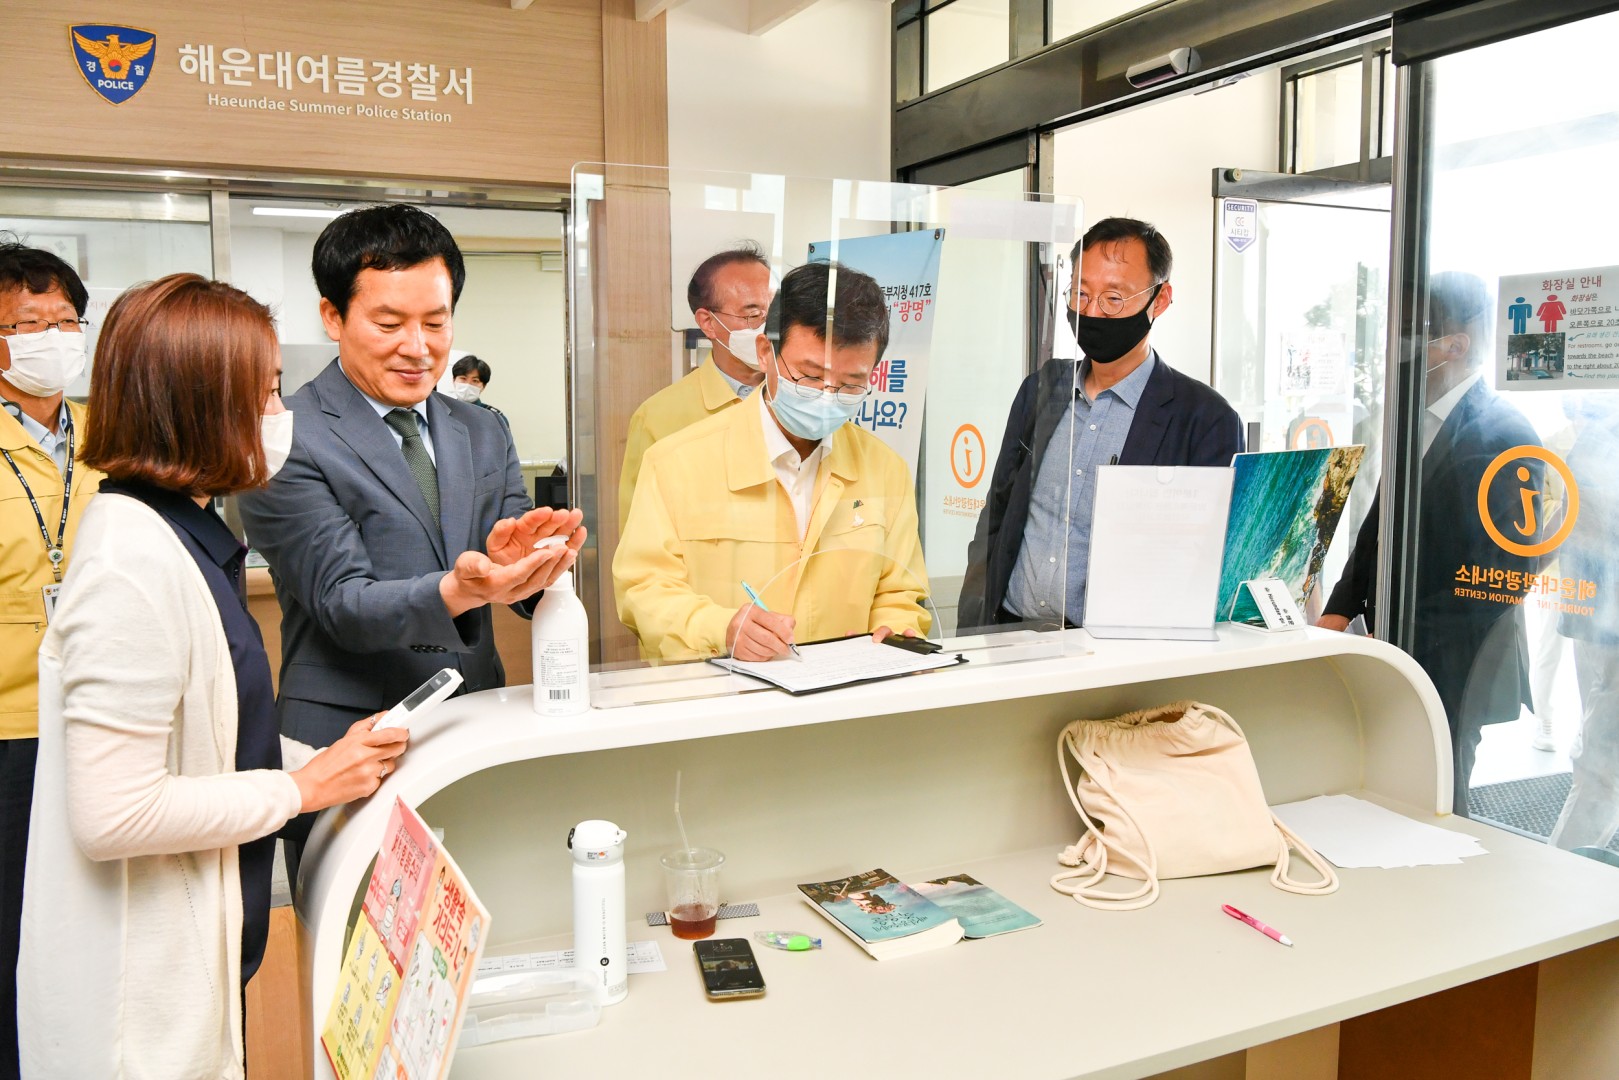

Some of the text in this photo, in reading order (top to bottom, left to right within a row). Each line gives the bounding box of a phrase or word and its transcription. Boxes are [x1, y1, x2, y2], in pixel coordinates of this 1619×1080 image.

[178, 43, 473, 104] 해운대여름경찰서
[97, 79, 135, 90] POLICE
[207, 93, 452, 123] Haeundae Summer Police Station
[1226, 203, 1254, 212] SECURITY
[909, 283, 932, 298] 417호
[1542, 275, 1602, 291] 화장실 안내
